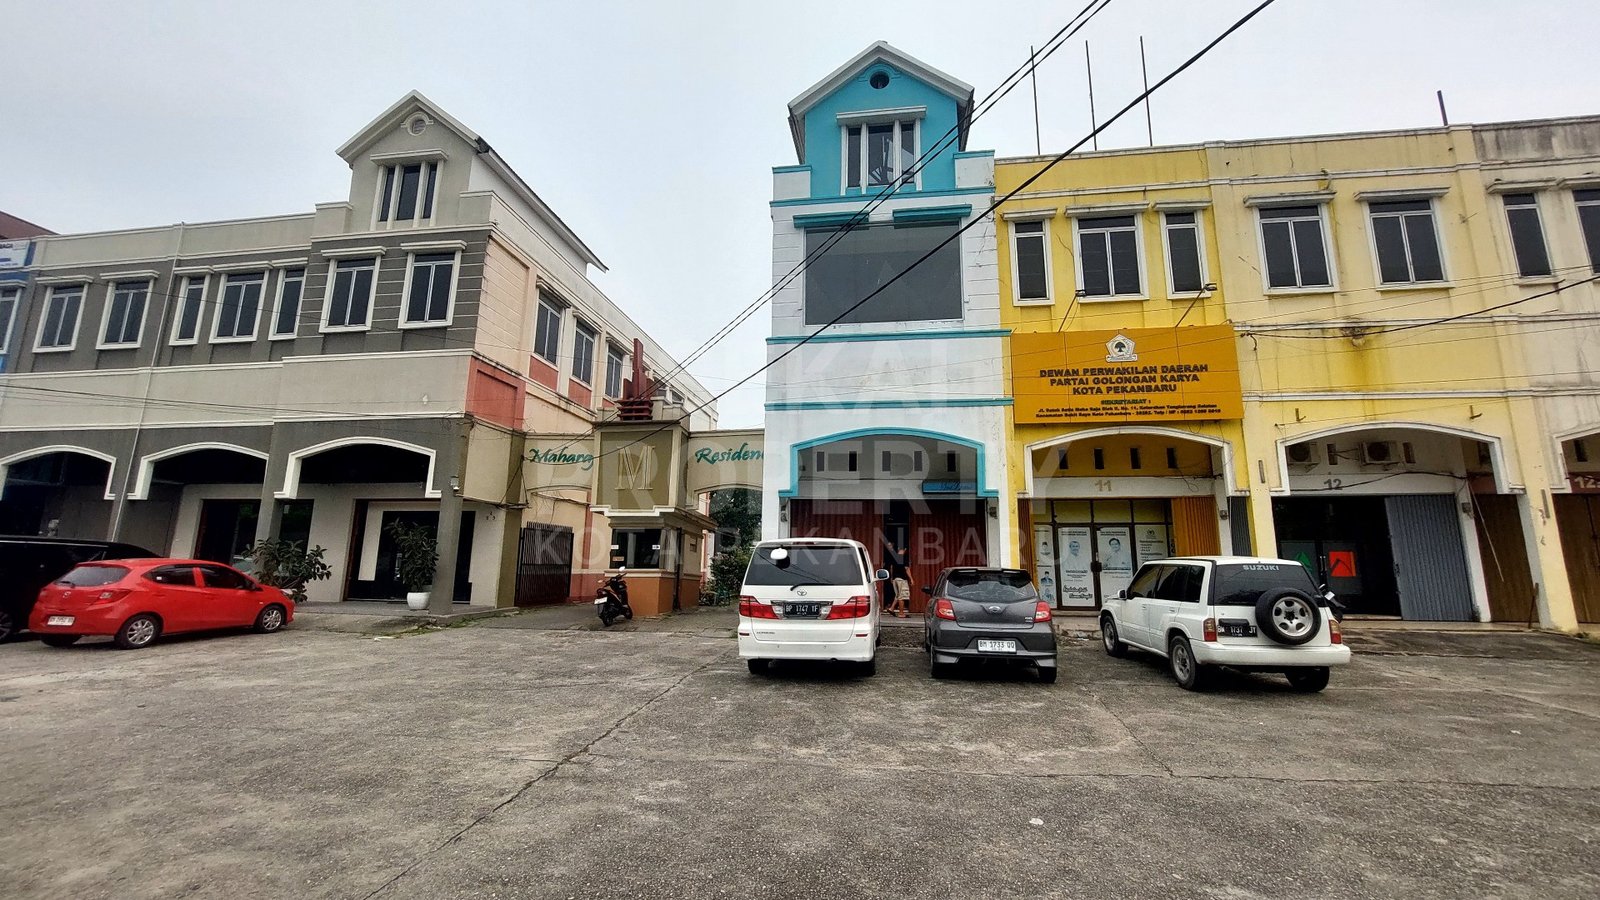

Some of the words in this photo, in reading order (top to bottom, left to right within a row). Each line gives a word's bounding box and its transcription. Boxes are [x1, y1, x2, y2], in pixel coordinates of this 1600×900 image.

[1039, 368, 1080, 377] DEWAN
[1082, 366, 1158, 376] PERWAKILAN
[1160, 363, 1208, 373] DAERAH
[1050, 377, 1089, 386] PARTAI
[1092, 375, 1157, 385] GOLONGAN
[1160, 373, 1200, 382] KARYA
[1072, 386, 1103, 395] KOTA
[1106, 384, 1177, 394] PEKANBARU
[695, 442, 764, 465] Residen
[1095, 479, 1112, 492] 11
[1323, 478, 1343, 490] 12
